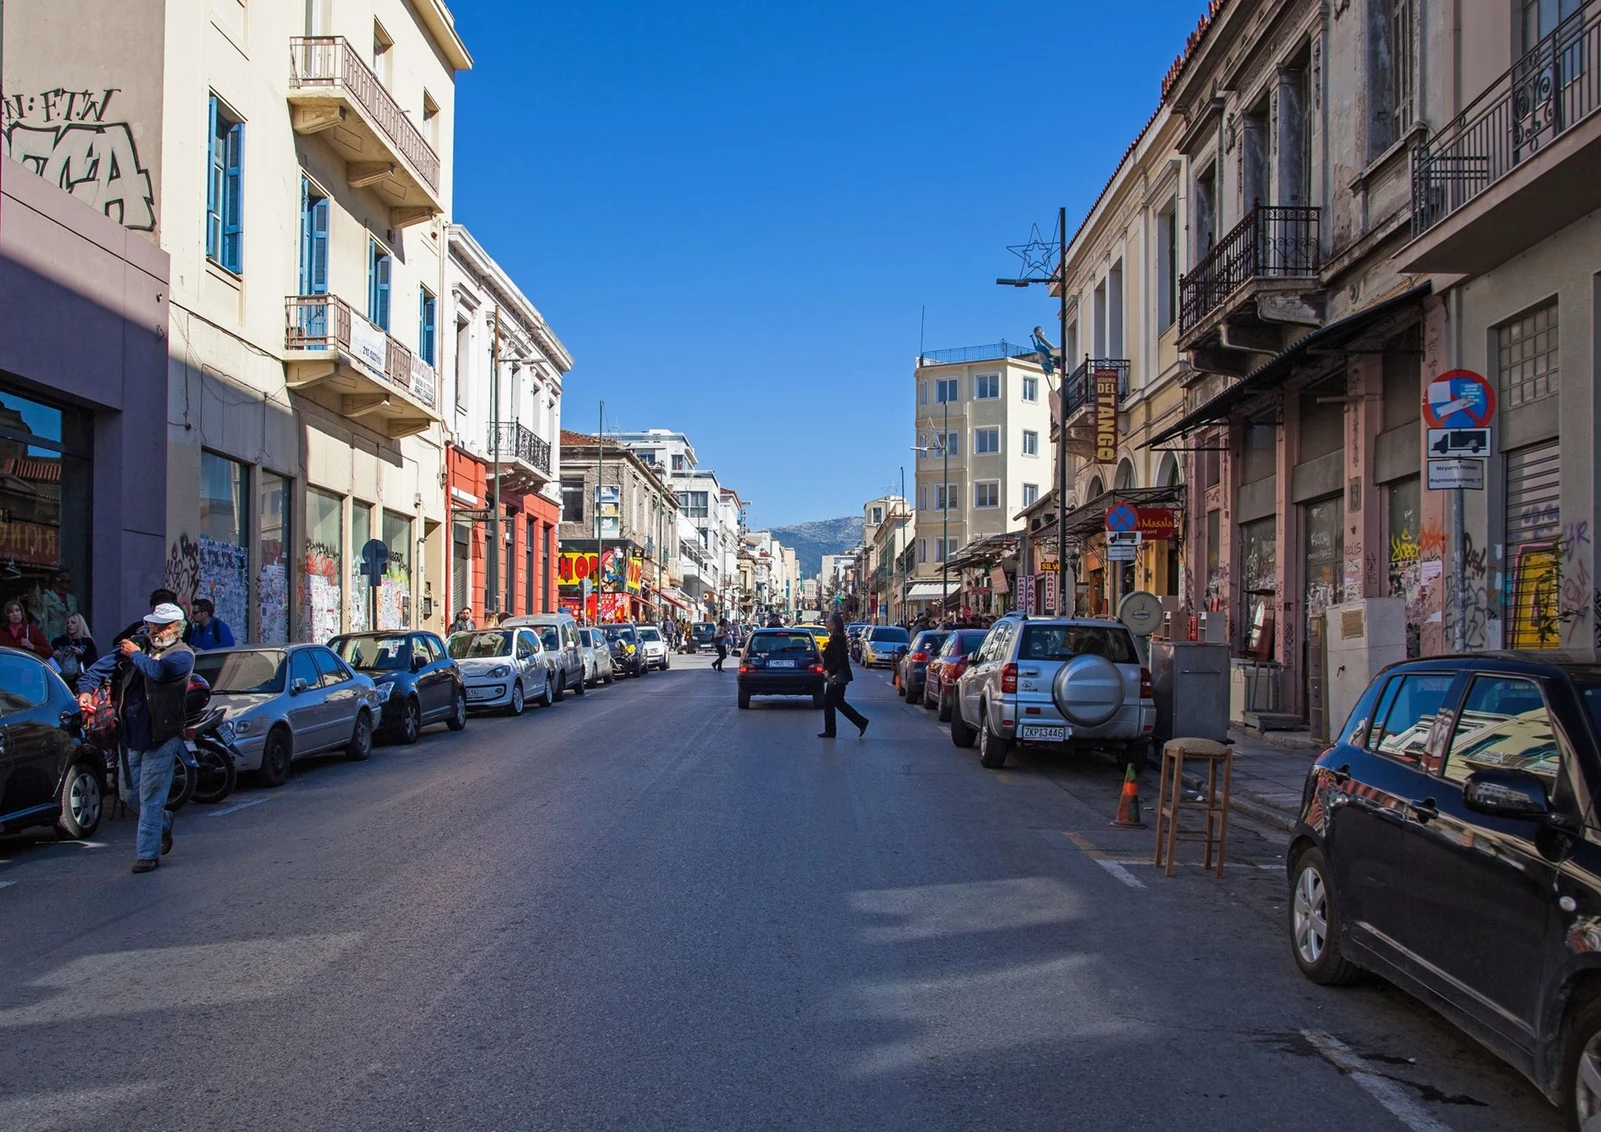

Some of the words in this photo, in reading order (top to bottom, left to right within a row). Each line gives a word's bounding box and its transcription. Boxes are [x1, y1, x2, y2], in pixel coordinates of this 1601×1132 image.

[1097, 383, 1116, 394] DEL
[1097, 395, 1115, 460] TANGO
[1142, 517, 1173, 528] Masala
[558, 554, 599, 582] HOP
